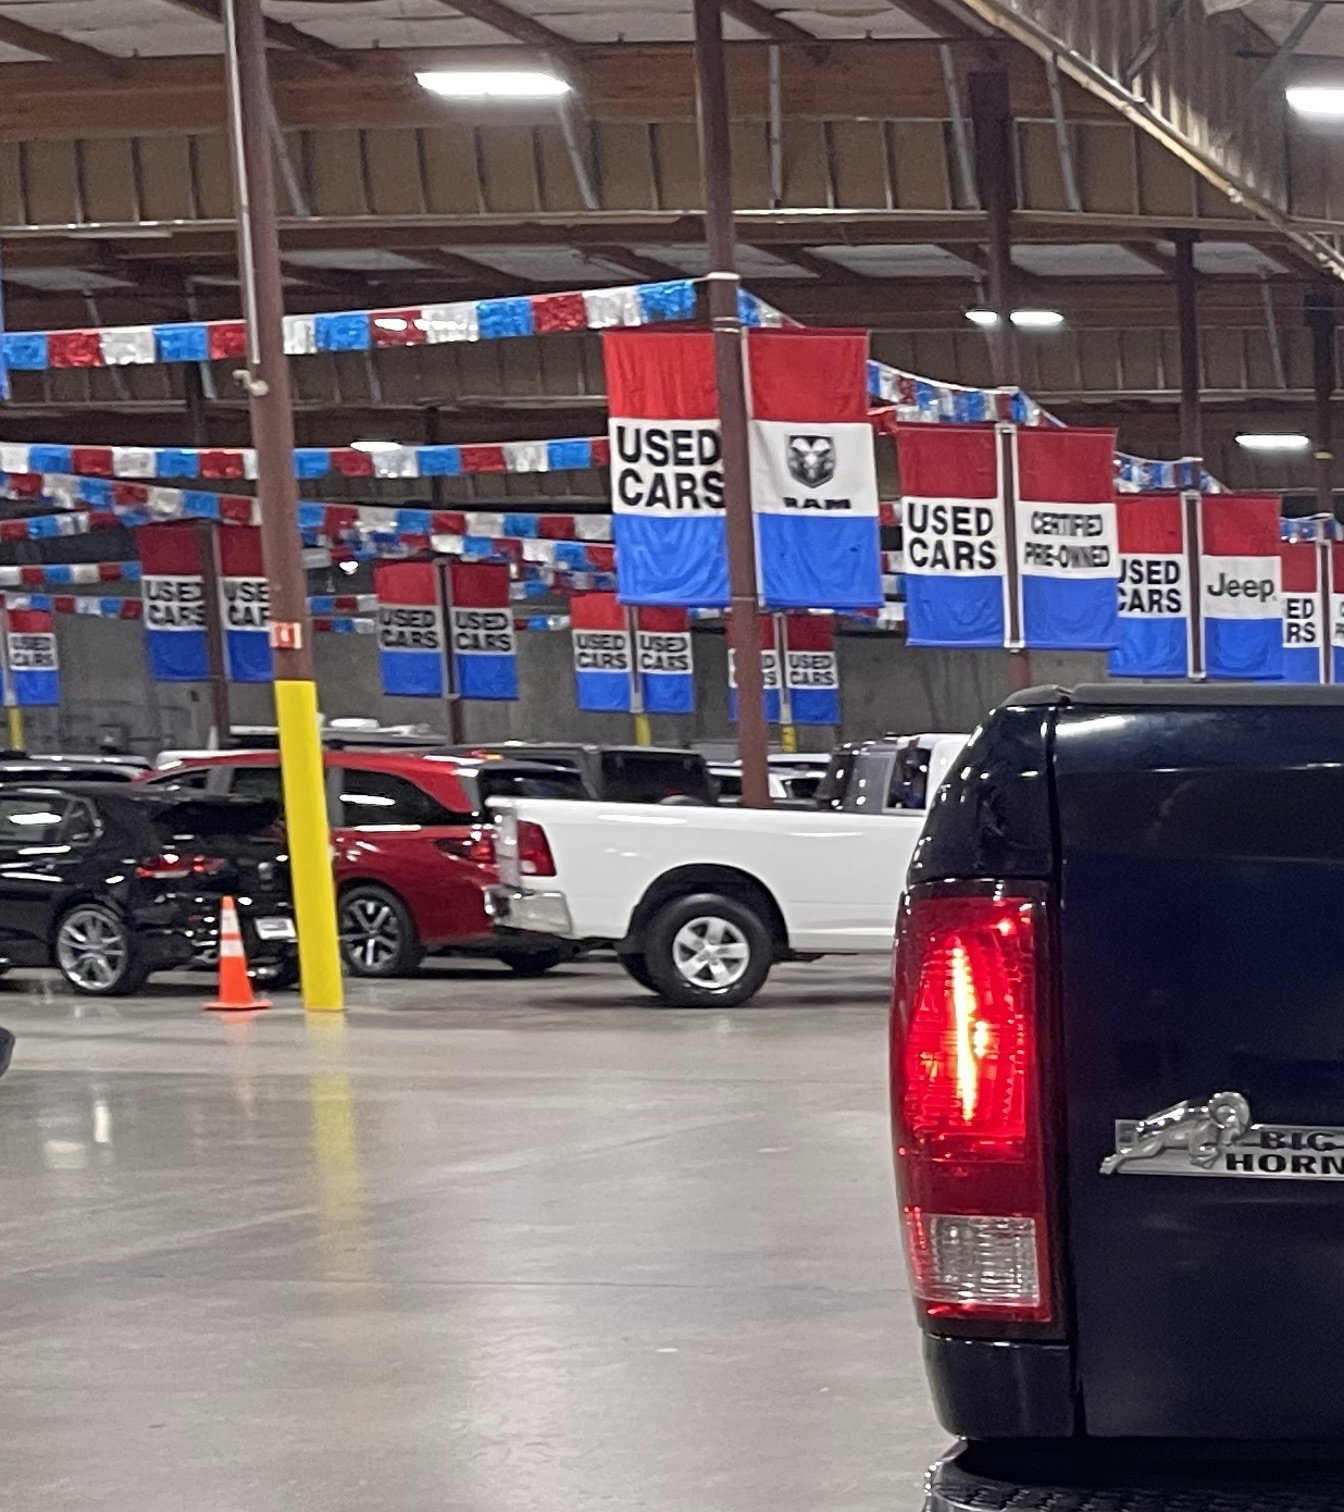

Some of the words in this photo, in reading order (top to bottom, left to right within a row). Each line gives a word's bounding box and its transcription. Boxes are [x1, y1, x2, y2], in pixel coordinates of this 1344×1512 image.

[616, 426, 721, 468] USED
[618, 468, 726, 509] CARS
[908, 503, 994, 537] USED
[1031, 511, 1103, 537] CERTIFIED
[909, 537, 997, 570] CARS
[1024, 542, 1110, 568] PRE-OWNED
[224, 580, 269, 600] USE
[1207, 573, 1275, 602] Jeep
[381, 607, 436, 628] USED
[1287, 598, 1315, 619] ED
[455, 611, 508, 631] USED
[382, 629, 438, 649] CARS
[456, 632, 511, 651] CARS
[576, 634, 626, 650] USED
[1286, 622, 1316, 643] RS
[640, 635, 688, 652] USED
[576, 653, 627, 669] CARS
[640, 653, 689, 670] CARS
[788, 654, 833, 670] USED
[789, 671, 835, 687] CARS
[1259, 1132, 1336, 1151] BIG
